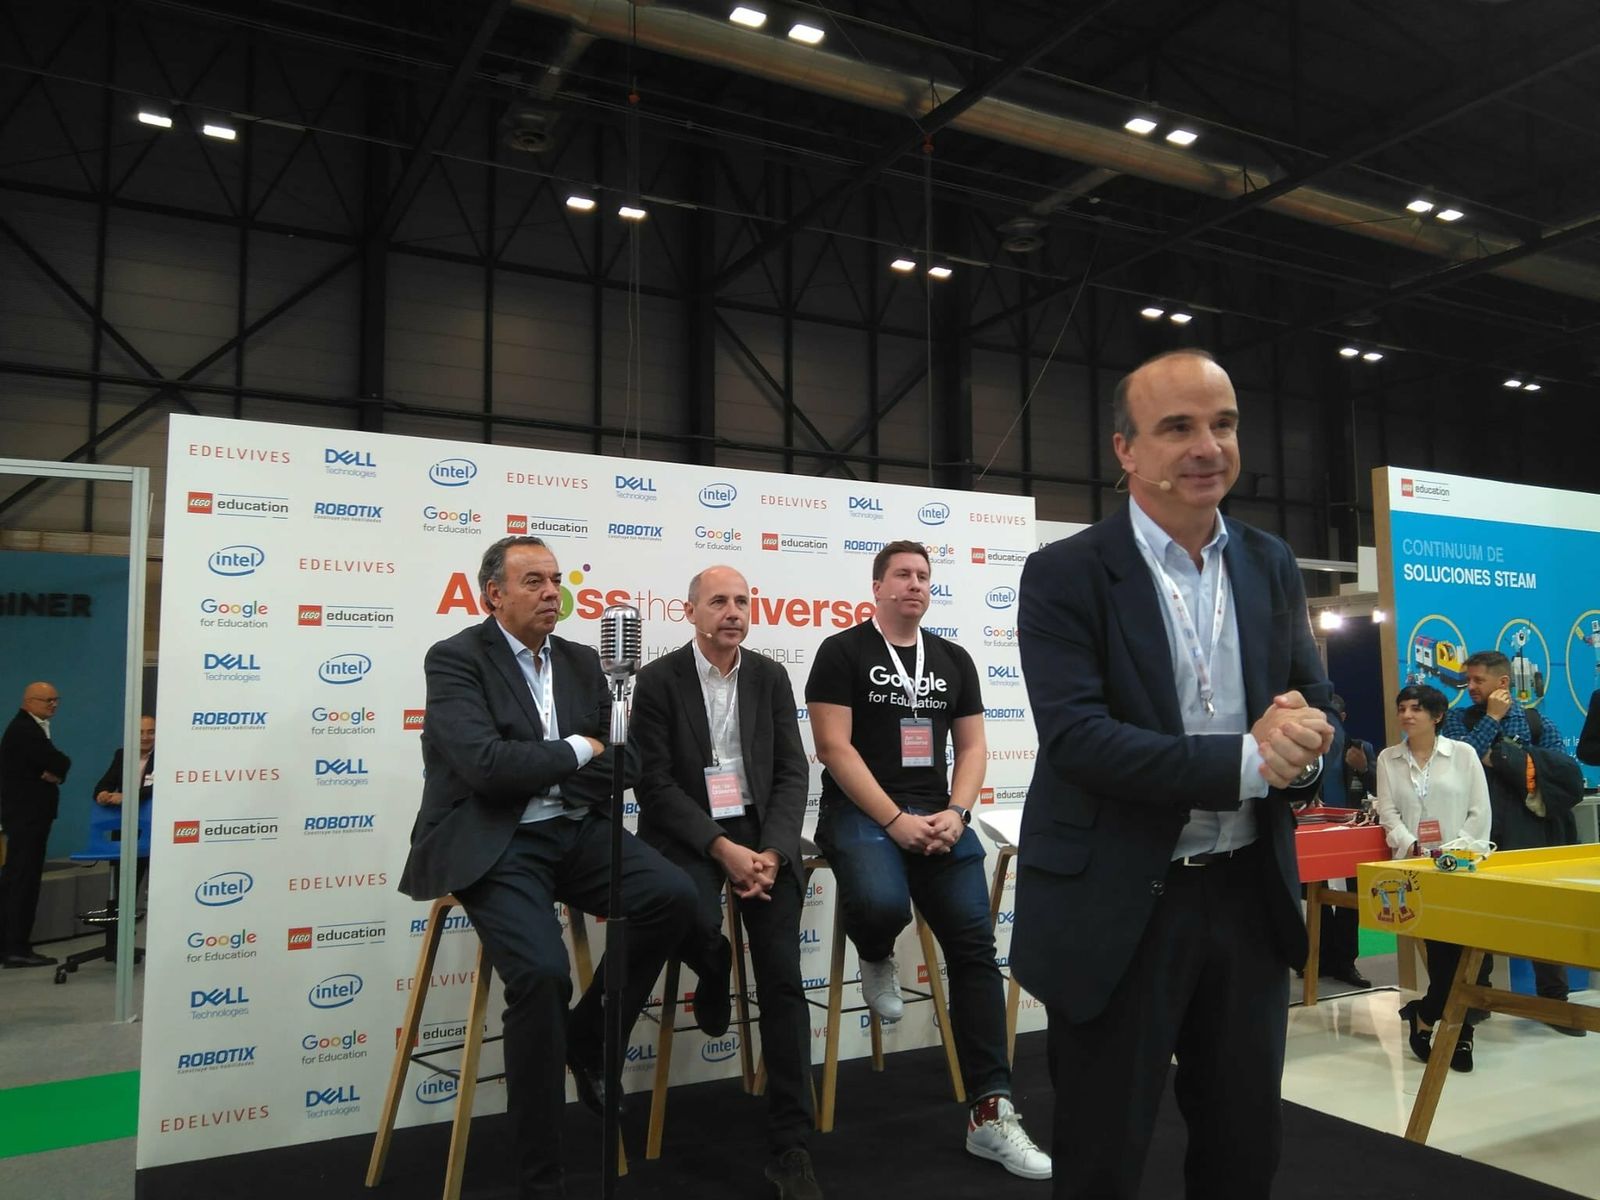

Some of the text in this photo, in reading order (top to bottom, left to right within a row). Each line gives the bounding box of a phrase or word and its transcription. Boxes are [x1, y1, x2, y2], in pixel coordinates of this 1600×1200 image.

[189, 444, 290, 464] EDELVIVES
[325, 448, 376, 467] DELL
[325, 466, 377, 479] Technologies
[436, 463, 470, 480] intel
[507, 472, 588, 490] EDELVIVES
[615, 475, 657, 492] DELL
[615, 491, 658, 502] Technologies
[703, 487, 731, 501] intel
[761, 494, 827, 510] EDELVIVES
[190, 497, 289, 514] LEGO education
[314, 502, 384, 519] ROBOTIX
[849, 496, 883, 511] DELL
[424, 505, 481, 525] Google
[921, 507, 945, 520] intel
[970, 511, 1026, 526] EDELVIVES
[423, 523, 482, 535] for Education
[508, 519, 588, 534] LEGO education
[608, 523, 663, 537] ROBOTIX
[695, 525, 742, 543] Google
[695, 542, 742, 552] for Education
[781, 538, 828, 550] education
[1402, 538, 1504, 563] CONTINUUM DE
[216, 551, 256, 568] intel
[299, 558, 395, 574] EDELVIVES
[1403, 563, 1537, 590] SOLUCIONES STEAM
[930, 583, 953, 597] ELL
[988, 591, 1012, 604] intel
[200, 598, 268, 618] Google
[300, 610, 394, 623] LEGO education
[634, 588, 687, 622] the
[750, 587, 876, 629] iverse
[200, 618, 268, 629] for Education
[204, 653, 261, 671] DELL
[326, 660, 363, 676] intel
[204, 671, 261, 683] Technologies
[988, 665, 1019, 679] DELL
[868, 690, 947, 710] for Eduation
[192, 711, 268, 726] ROBOTIX
[311, 706, 375, 725] Google
[311, 725, 375, 736] for Education
[315, 758, 368, 776] DELL
[175, 768, 280, 784] EDELVIVES
[315, 776, 369, 788] Technologies
[175, 822, 278, 838] LEGO education
[304, 814, 376, 831] ROBOTIX
[203, 878, 244, 896] intel
[289, 872, 387, 892] EDELVIVES
[187, 928, 257, 949] Google
[290, 926, 386, 945] LEGO education
[187, 949, 257, 964] for Education
[190, 986, 249, 1009] DELL
[316, 982, 354, 1000] intel
[191, 1007, 249, 1021] Technologies
[302, 1029, 367, 1050] Google
[707, 1037, 736, 1054] intel
[178, 1046, 258, 1070] ROBOTIX
[301, 1050, 367, 1065] for Education
[625, 1044, 657, 1062] ELL
[423, 1078, 457, 1095] intel
[305, 1085, 360, 1108] DELL
[160, 1105, 270, 1134] EDELVIVES
[305, 1106, 360, 1120] Technologies
